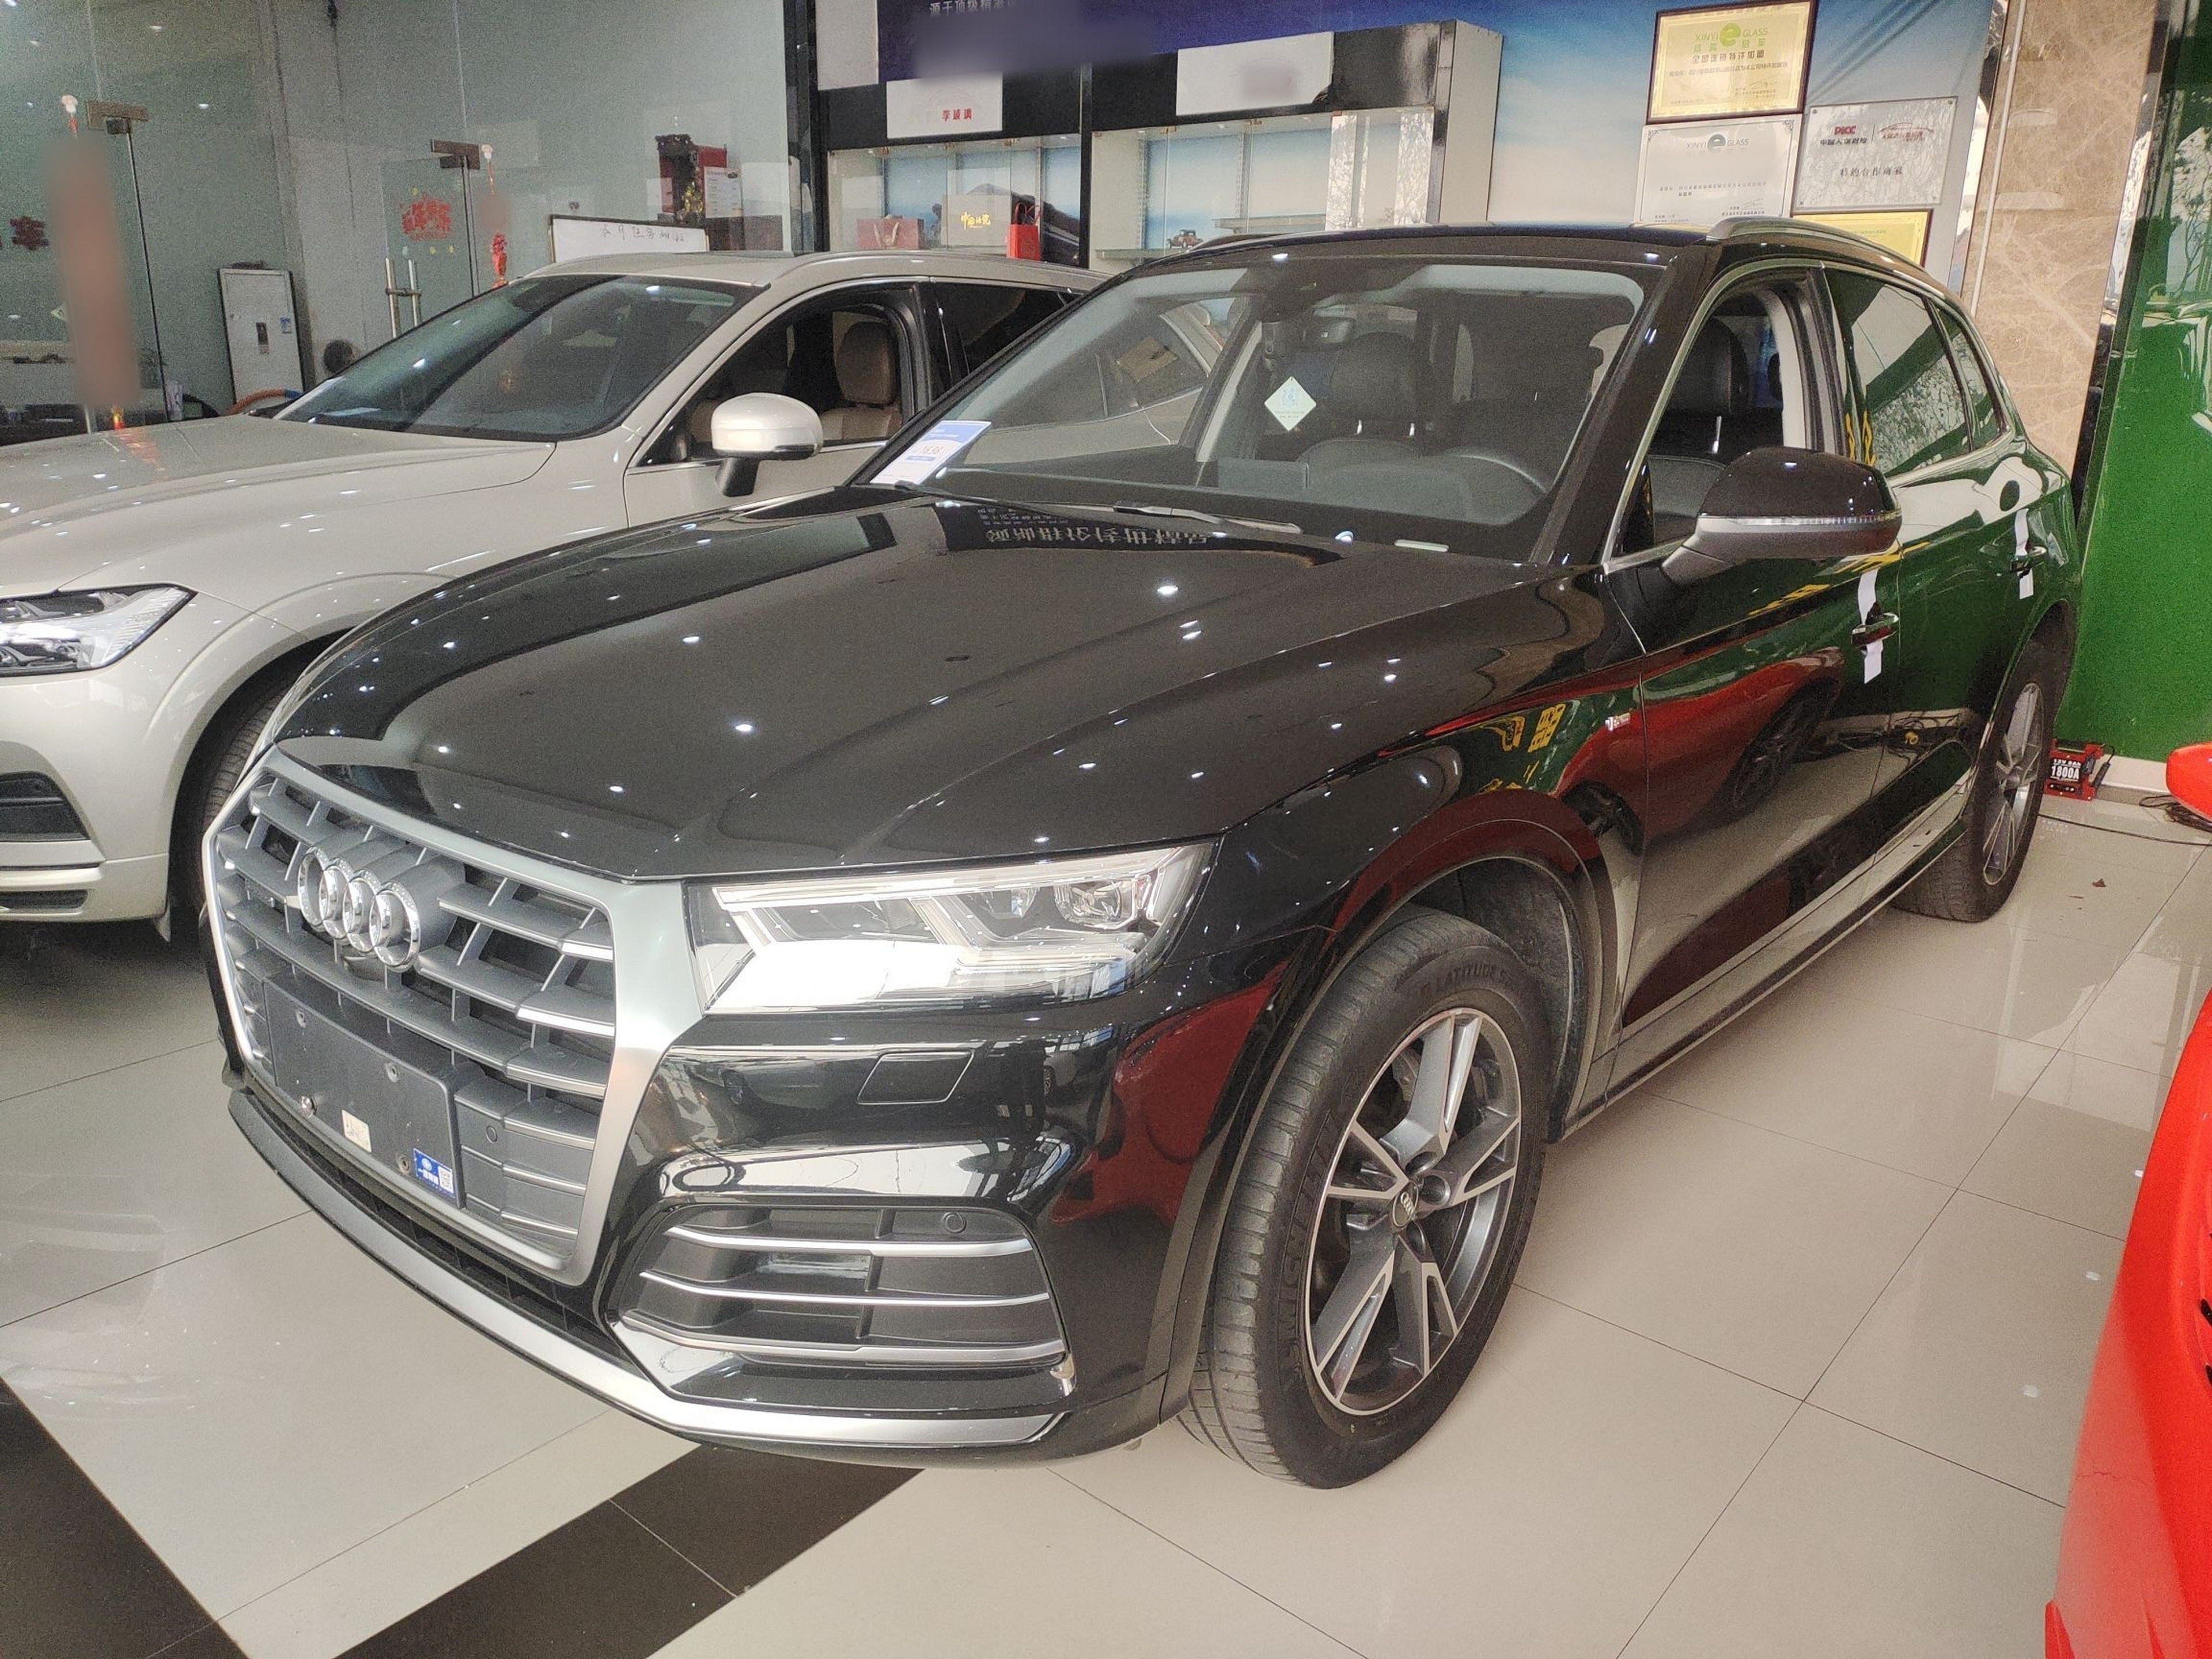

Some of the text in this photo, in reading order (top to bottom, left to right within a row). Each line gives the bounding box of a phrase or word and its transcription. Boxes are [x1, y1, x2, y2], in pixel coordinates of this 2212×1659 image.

[1694, 32, 1718, 42] XINYI
[1743, 28, 1768, 38] GLASS
[1834, 124, 1857, 136] PICC
[1685, 142, 1707, 150] XINYI
[1728, 138, 1749, 147] GLASS
[2051, 765, 2080, 779] 1800A
[1435, 963, 1497, 993] LATITUDE
